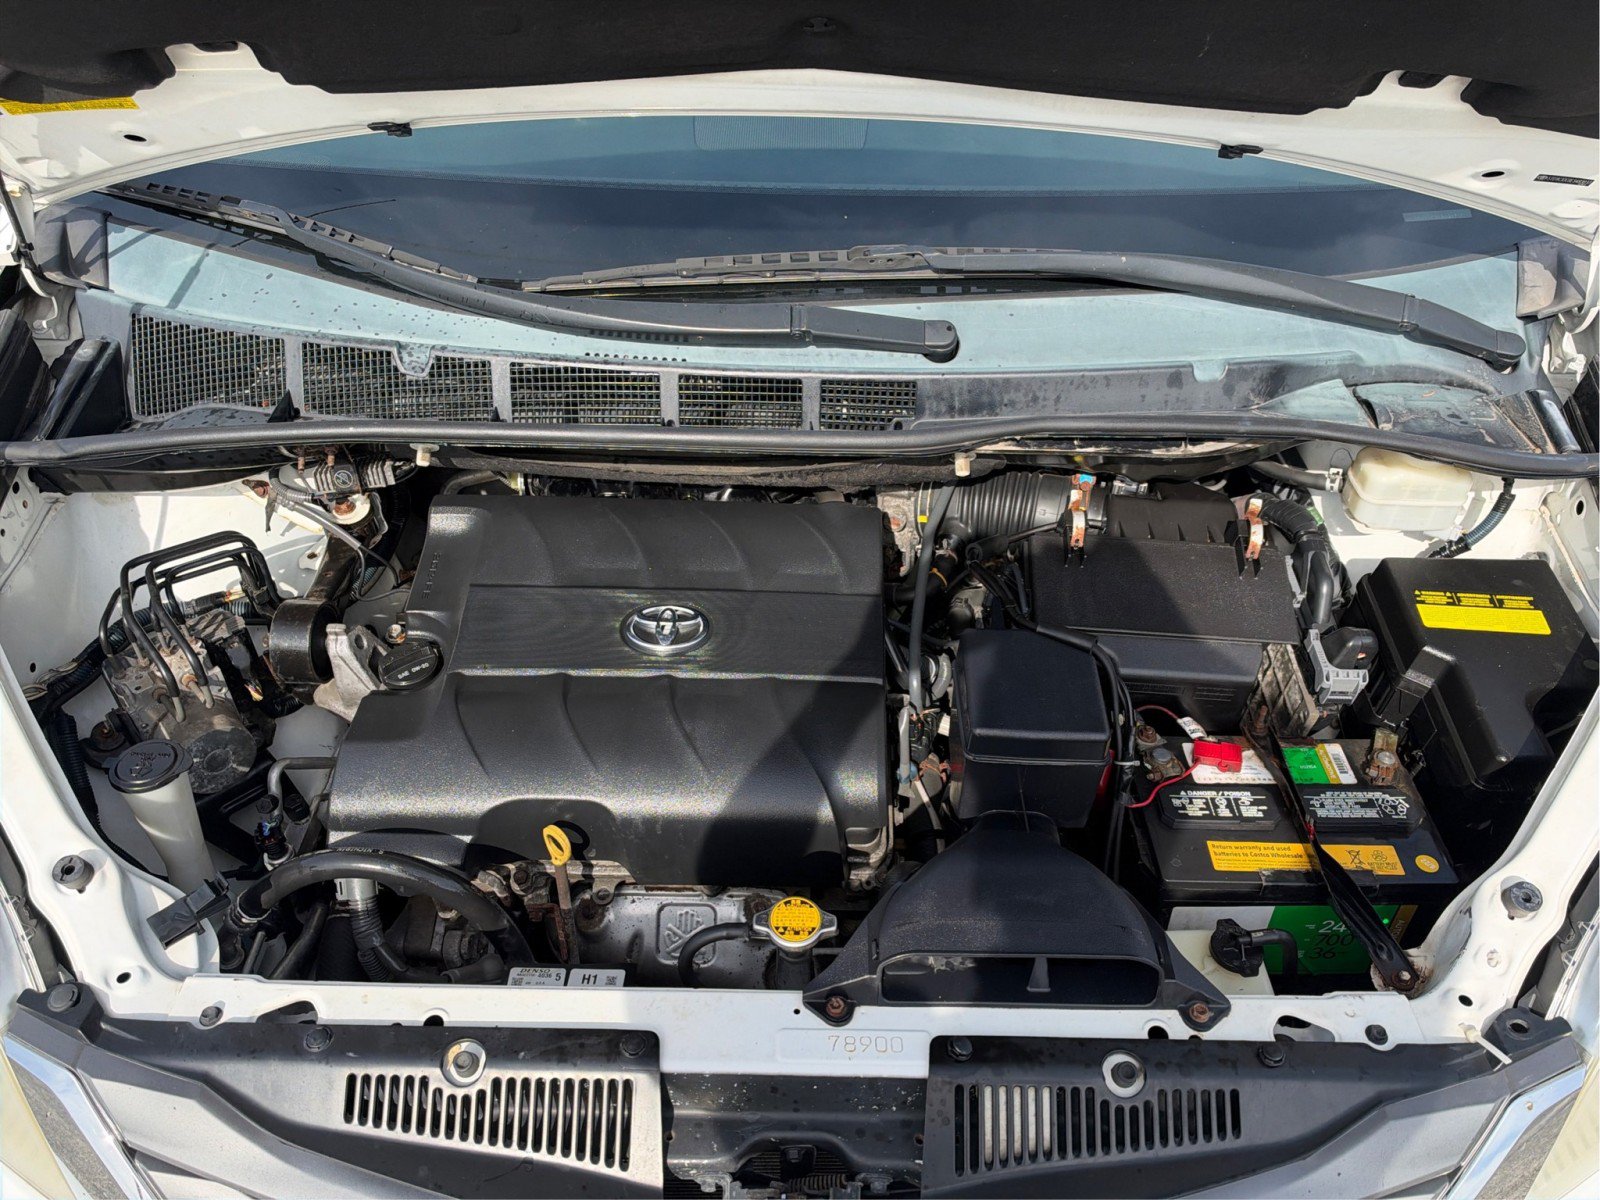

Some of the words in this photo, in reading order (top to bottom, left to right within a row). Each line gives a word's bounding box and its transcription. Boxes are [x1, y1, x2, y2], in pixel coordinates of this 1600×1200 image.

[397, 669, 411, 680] SAE
[1234, 844, 1262, 852] warranty
[1213, 850, 1241, 858] batteries
[1249, 851, 1270, 859] Costco
[1271, 851, 1304, 859] Wholesale
[1314, 933, 1355, 947] 700
[1309, 947, 1337, 960] 36
[554, 972, 562, 982] 5
[581, 973, 598, 985] H1
[827, 1034, 905, 1054] 78900
